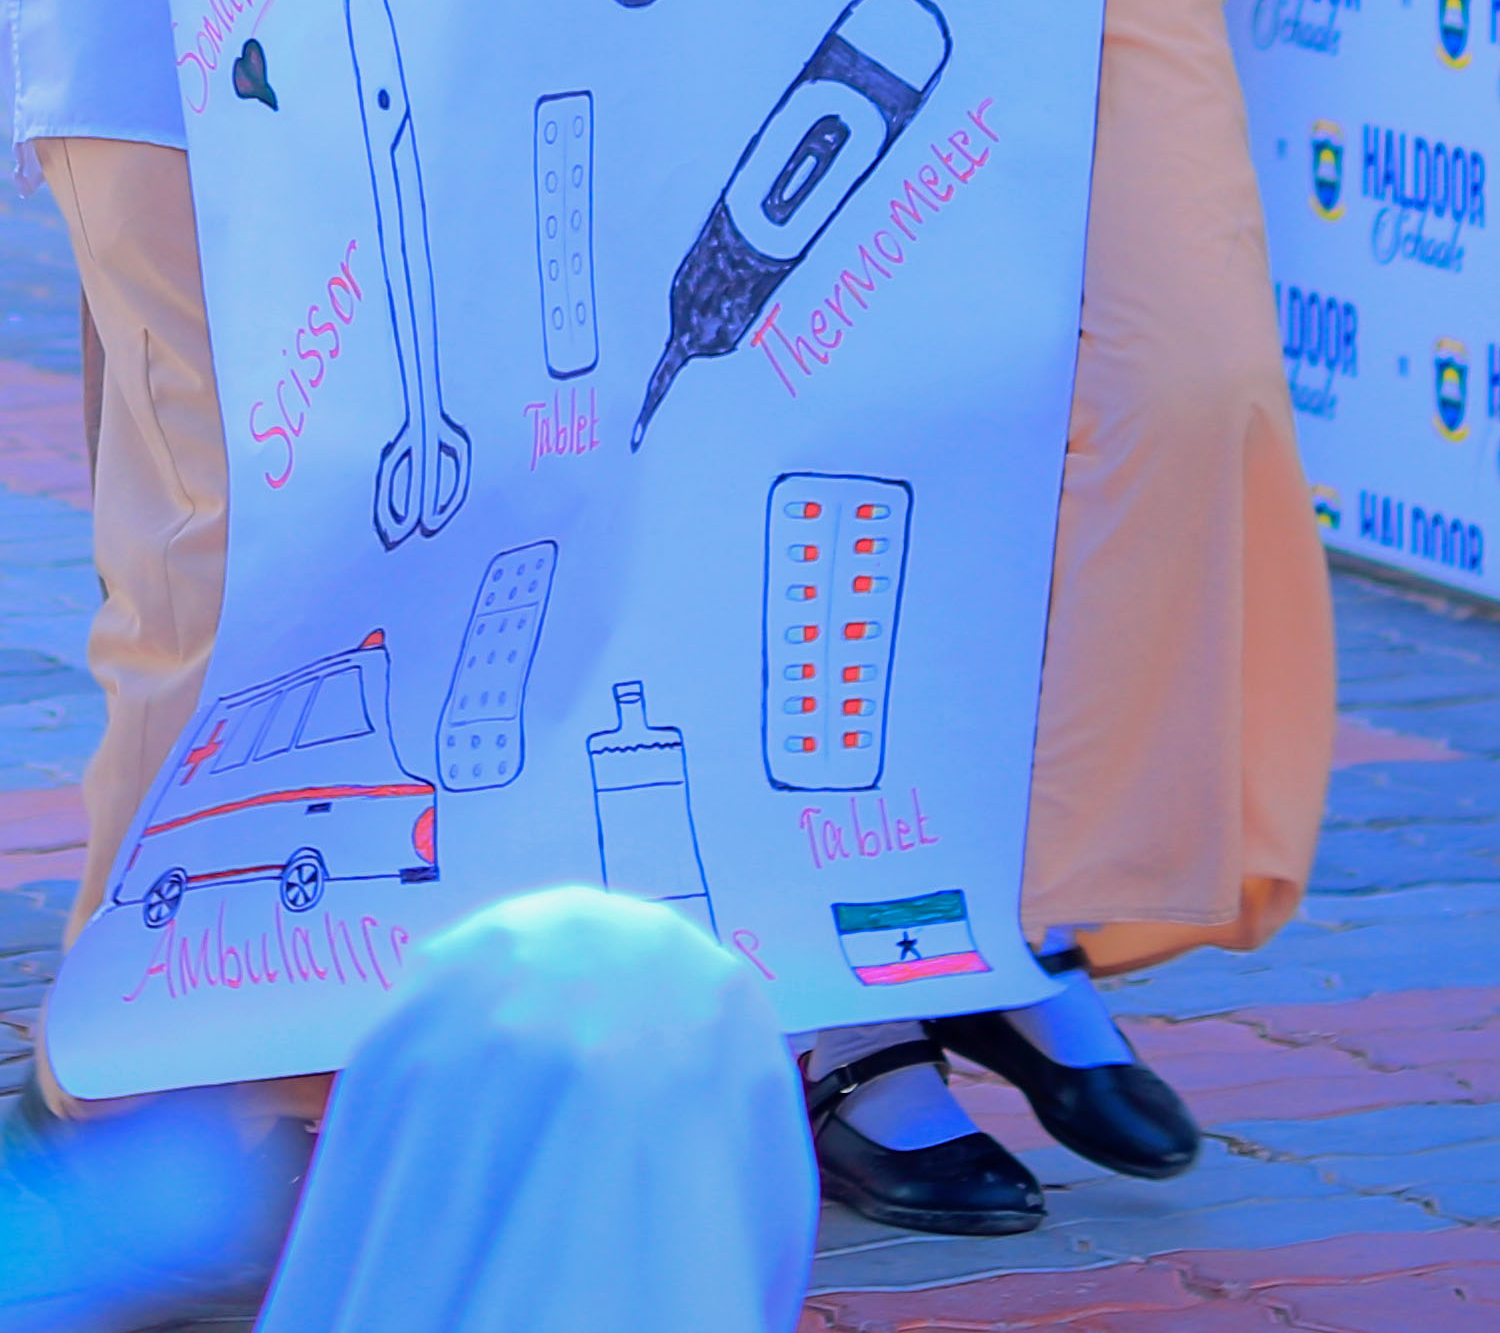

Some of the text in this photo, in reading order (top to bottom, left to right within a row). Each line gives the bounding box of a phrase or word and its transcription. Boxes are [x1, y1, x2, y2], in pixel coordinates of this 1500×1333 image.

[1362, 123, 1486, 229] HALDOOR
[250, 239, 363, 489] Scissor
[522, 386, 601, 472] Tablet
[799, 786, 940, 870] Tablet
